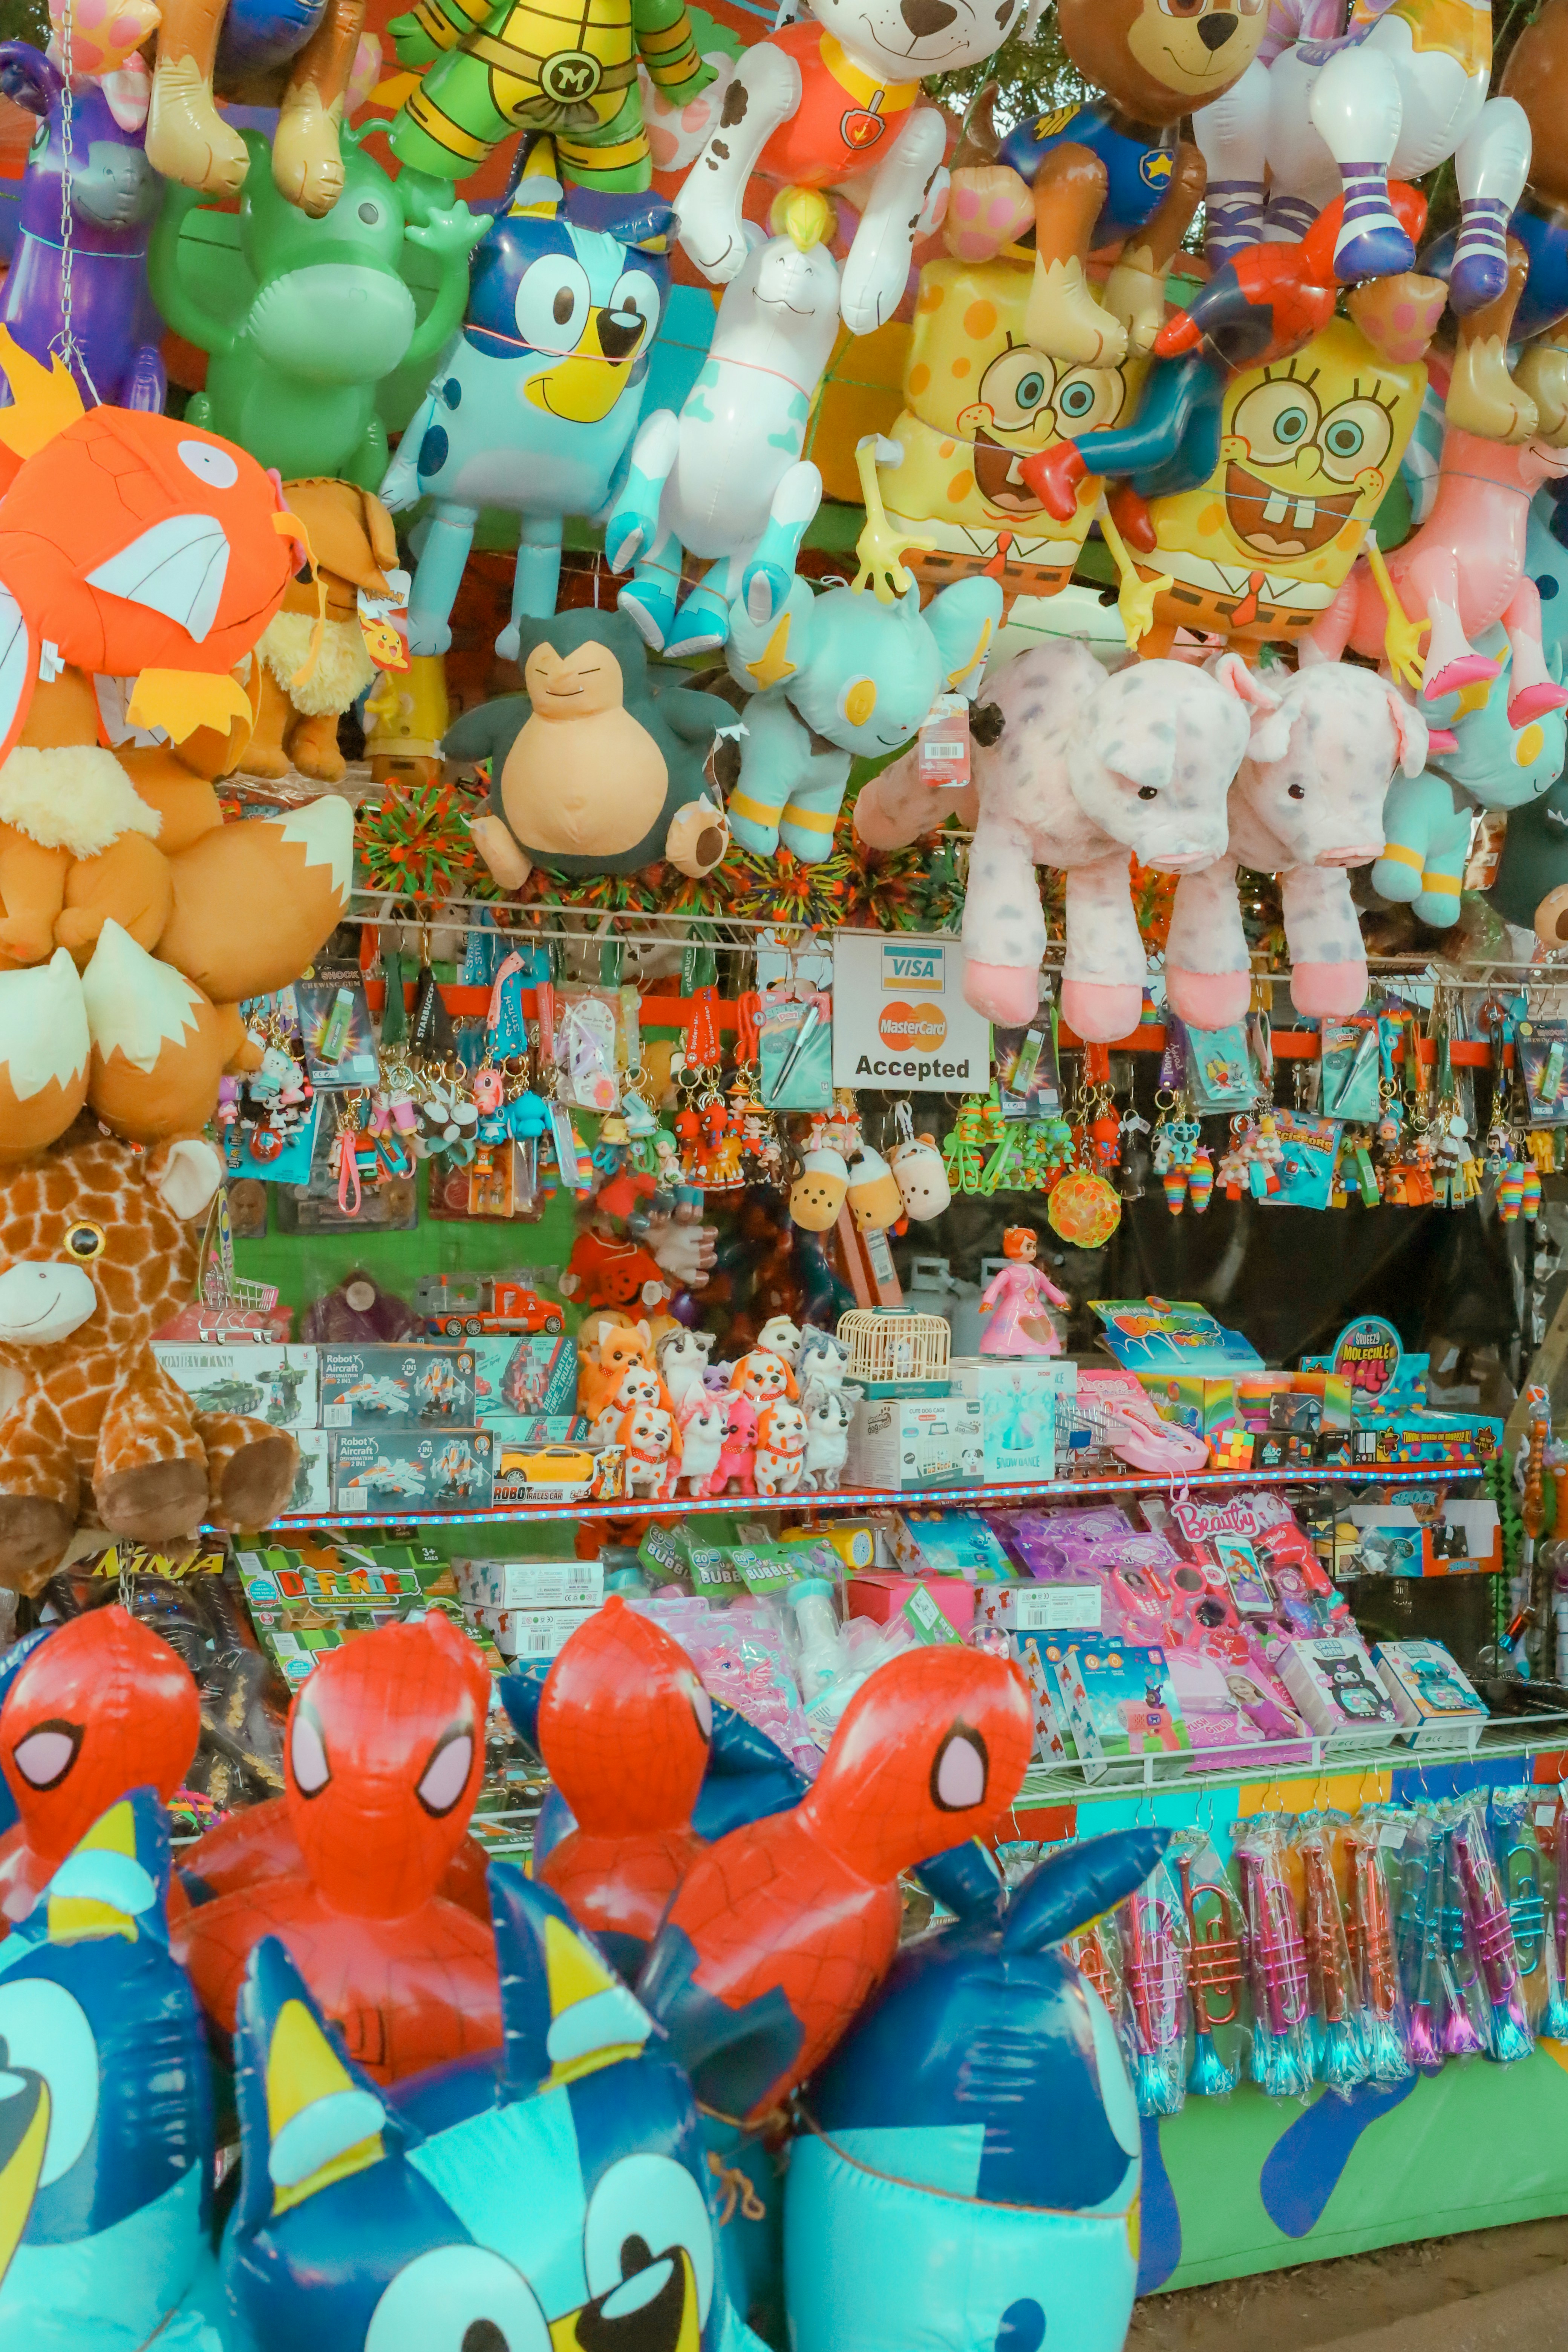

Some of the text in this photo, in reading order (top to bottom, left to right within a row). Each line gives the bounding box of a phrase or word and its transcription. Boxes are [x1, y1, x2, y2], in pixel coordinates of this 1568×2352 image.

[559, 66, 590, 92] M
[892, 959, 934, 977] VISA
[321, 971, 360, 980] SHOCK
[779, 1012, 798, 1020] pen
[705, 1006, 715, 1044] Spider-Man
[880, 1019, 945, 1035] MasterCard
[855, 1055, 969, 1081] Accepted
[1276, 1130, 1333, 1150] SCISSORS
[1364, 1165, 1375, 1187] MARVEL
[1096, 1303, 1149, 1315] Rainbow
[1356, 1332, 1380, 1345] SQUEEZY
[1343, 1342, 1390, 1361] MOLECULE
[159, 1356, 233, 1367] COMBAT TANK
[327, 1355, 352, 1363] Robot
[326, 1364, 358, 1372] Aircraft
[543, 1340, 573, 1410] DEFORMATION
[548, 1391, 560, 1415] FIRE
[558, 1355, 574, 1388] TRUCK
[868, 1419, 890, 1433] dog sound
[341, 1437, 368, 1446] Robot
[340, 1446, 373, 1455] Aircraft
[996, 1455, 1040, 1469] SNOW DANCE
[493, 1487, 533, 1501] ROBOT
[570, 1487, 591, 1499] 2-in-1
[1391, 1490, 1438, 1505] SHOCK
[1174, 1502, 1257, 1541] Beauty
[422, 1548, 435, 1556] 3+
[734, 1554, 745, 1563] 20
[92, 1545, 224, 1580] NINJA
[745, 1562, 795, 1580] BUBBLE
[277, 1572, 416, 1596] DEFENDER
[465, 1627, 479, 1635] 3+
[1315, 1640, 1341, 1649] SPEED
[1149, 1651, 1159, 1660] 3+
